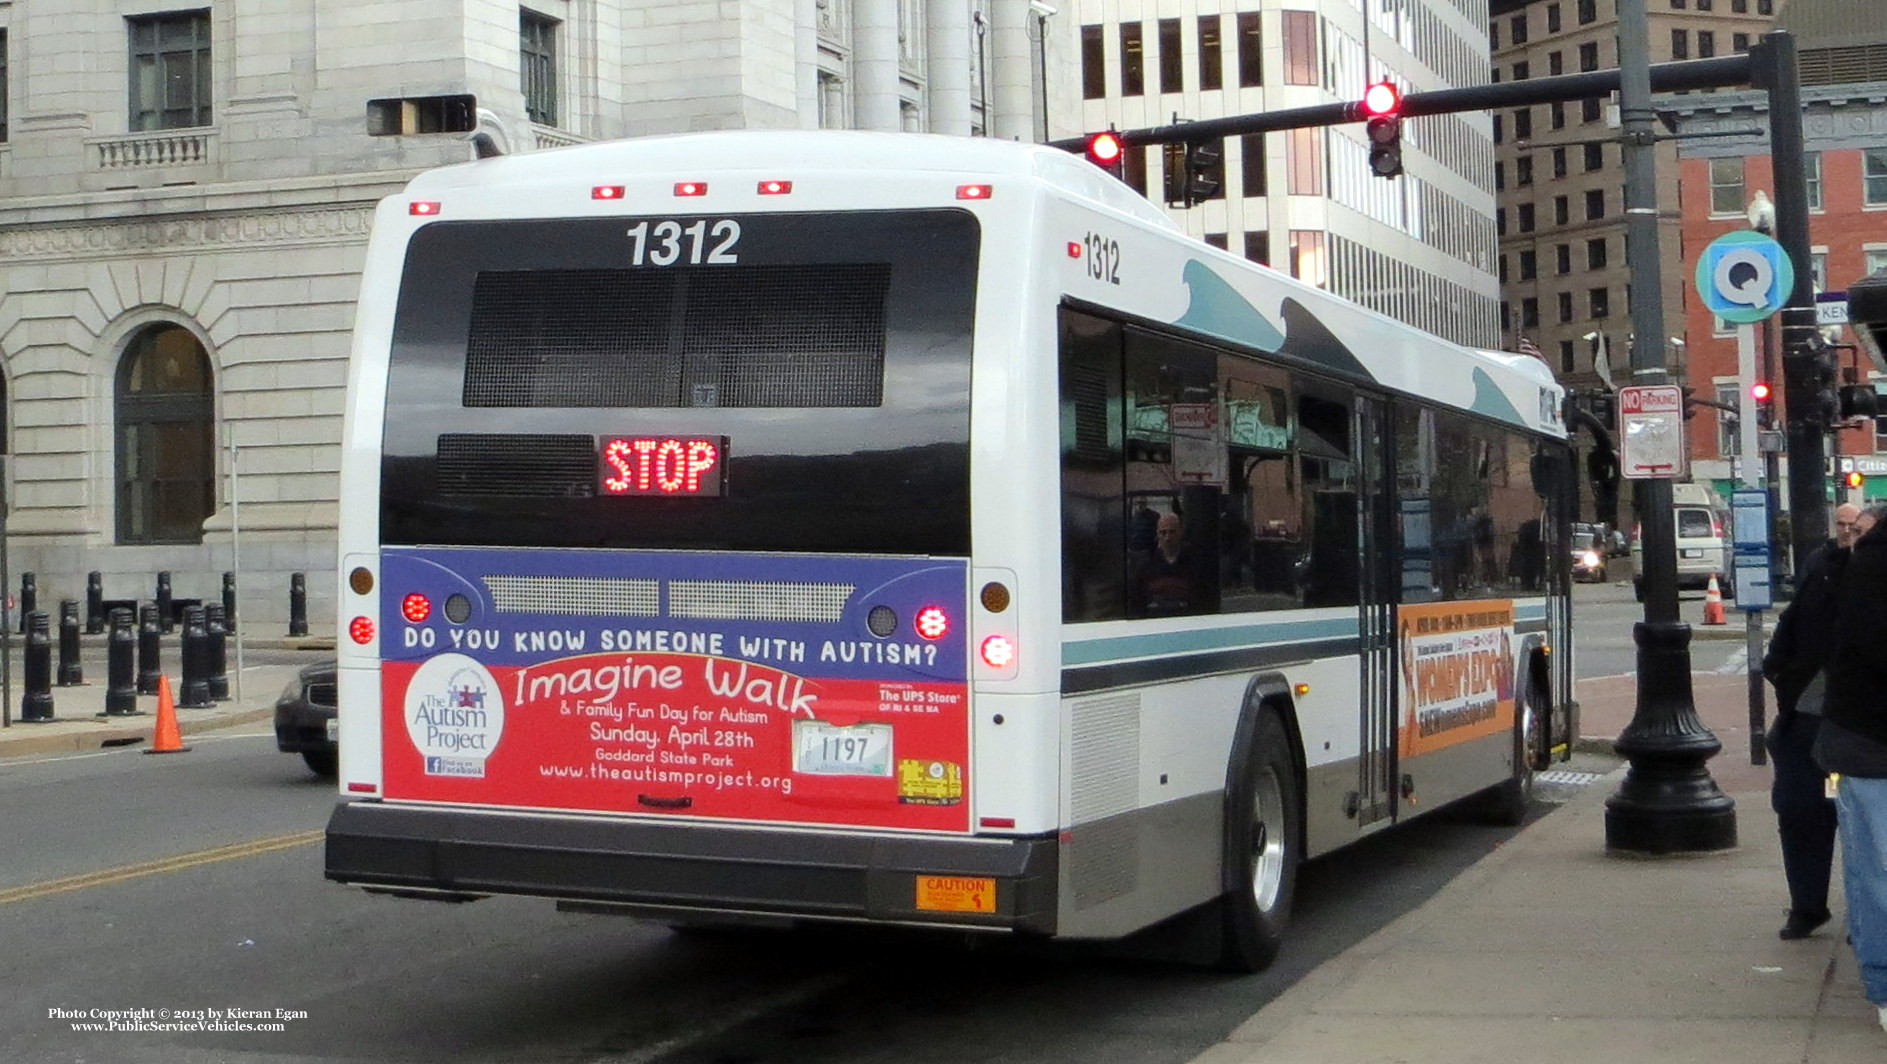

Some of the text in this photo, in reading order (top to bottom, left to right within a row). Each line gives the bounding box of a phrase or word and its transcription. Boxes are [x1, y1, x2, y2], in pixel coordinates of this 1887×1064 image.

[627, 219, 741, 266] 1312
[1084, 231, 1120, 286] 1312
[1714, 249, 1773, 309] Q
[1623, 391, 1677, 410] NO PARKING
[604, 439, 717, 492] STOP
[404, 627, 938, 666] DO YOU KNOW SOMEONE WITH AUTISM?
[515, 657, 818, 719] Imagine Walk
[880, 689, 900, 702] The
[902, 690, 925, 703] UPS
[414, 694, 487, 728] The Autism
[560, 700, 769, 724] & Family Fun Day for Autism
[427, 725, 487, 752] Project
[668, 725, 710, 750] April
[714, 730, 754, 748] 28th
[823, 737, 867, 763] 1197
[595, 748, 734, 767] Goddard State Park
[540, 763, 792, 794] www.theautismproject.org
[927, 879, 985, 892] CAUTION
